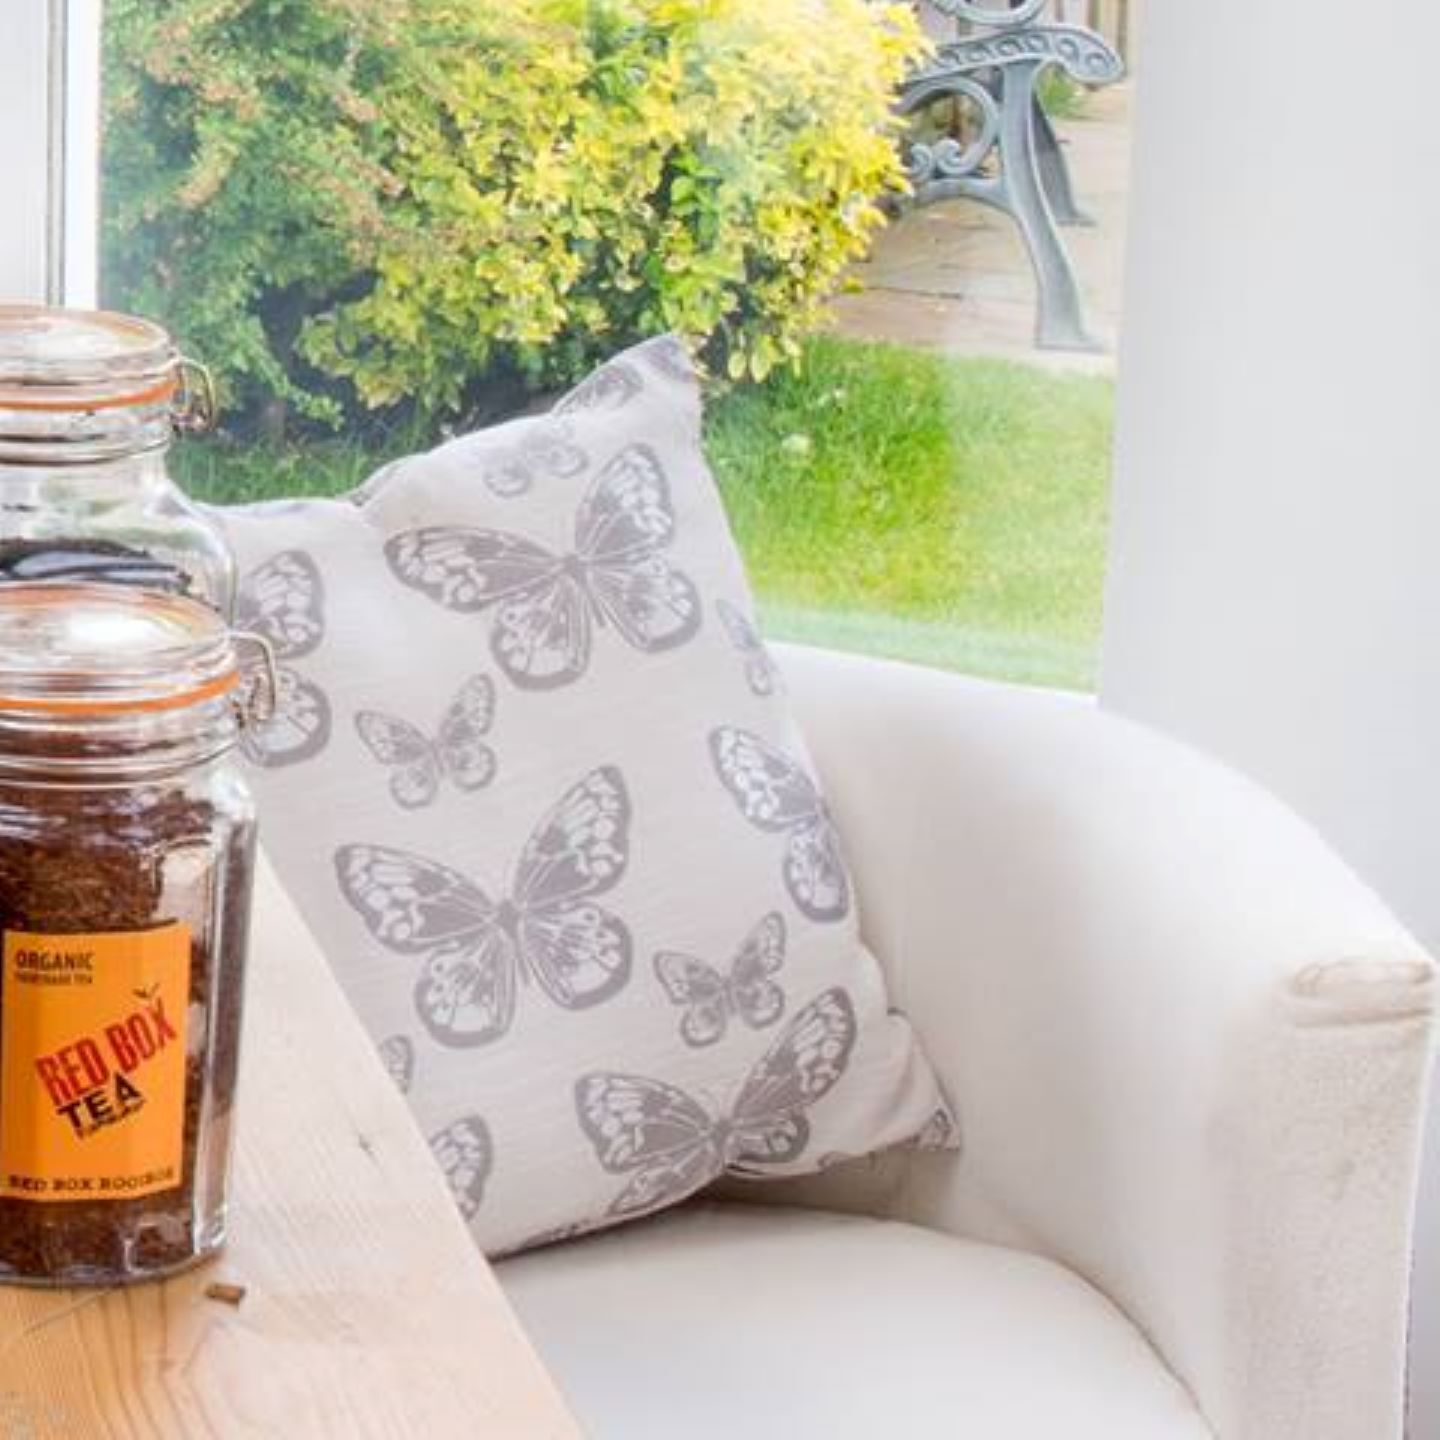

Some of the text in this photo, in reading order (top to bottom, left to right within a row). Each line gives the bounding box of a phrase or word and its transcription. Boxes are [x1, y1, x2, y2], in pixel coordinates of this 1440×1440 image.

[15, 949, 95, 971] ORGANIC
[34, 996, 178, 1107] RED BOX
[56, 1072, 143, 1138] TEA
[9, 1174, 48, 1191] RED
[52, 1176, 94, 1191] BOX
